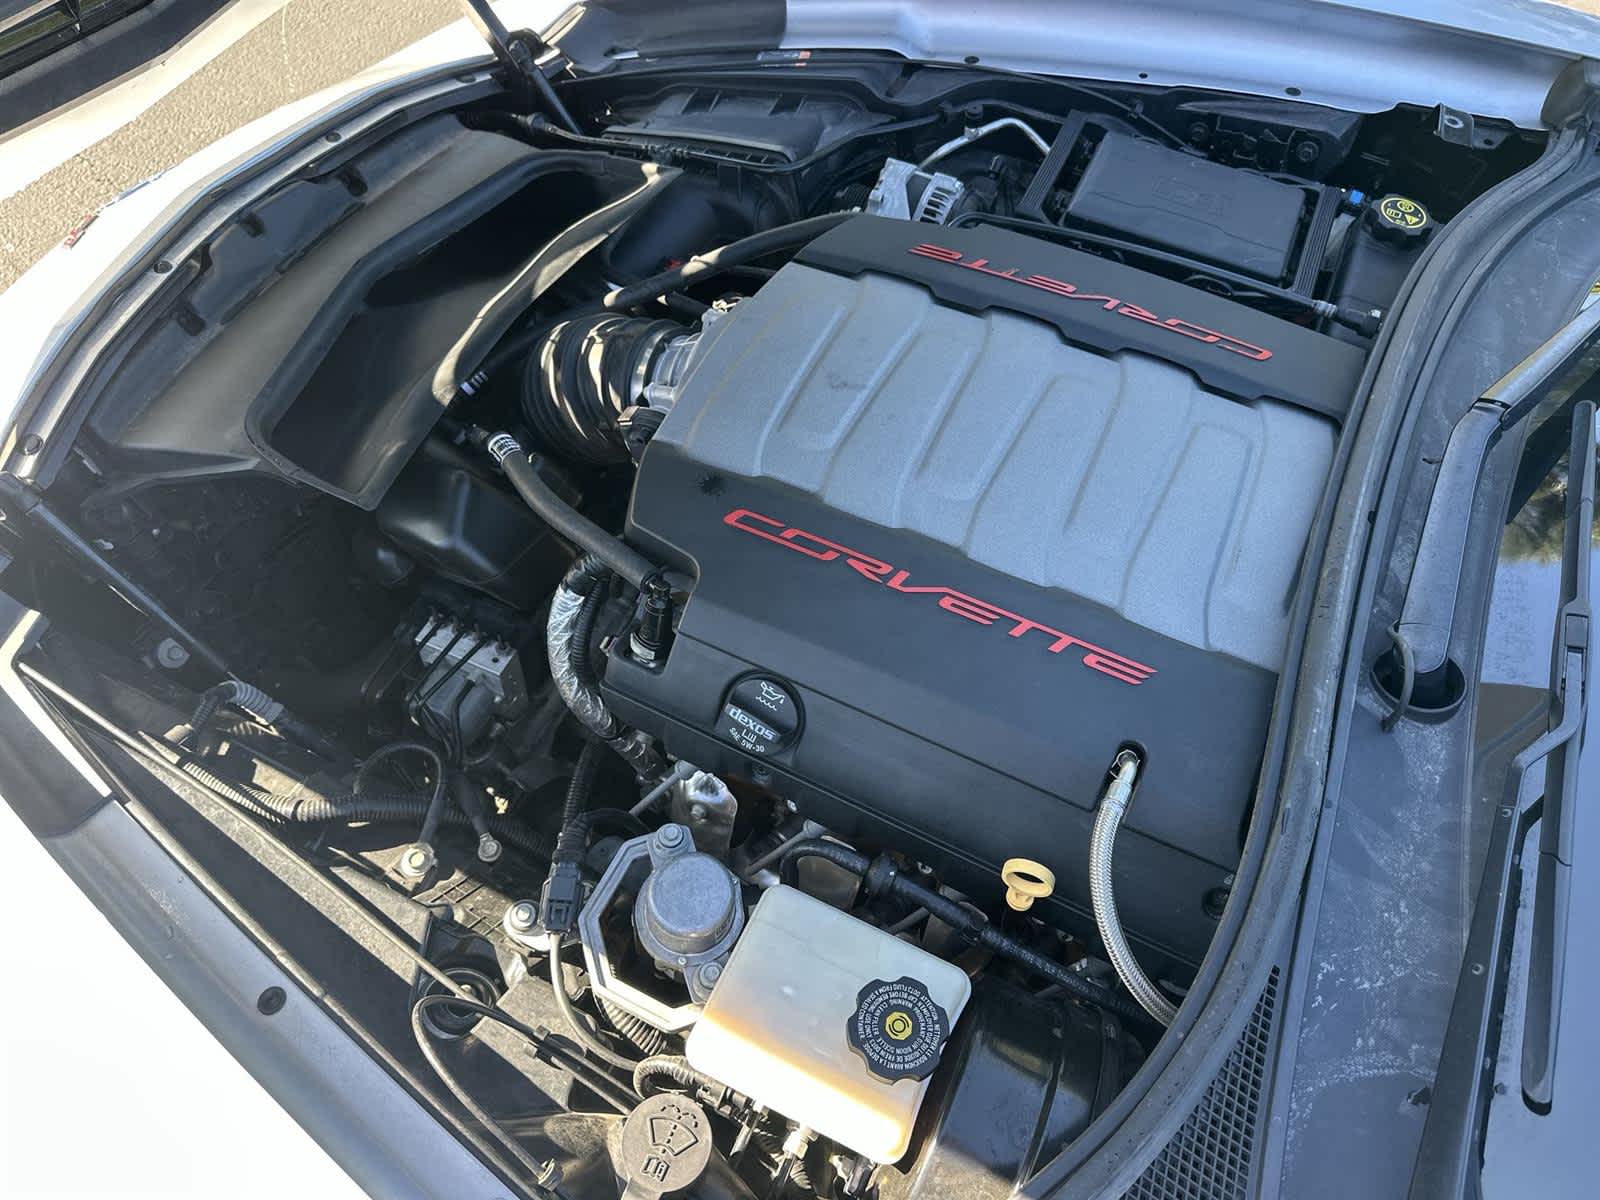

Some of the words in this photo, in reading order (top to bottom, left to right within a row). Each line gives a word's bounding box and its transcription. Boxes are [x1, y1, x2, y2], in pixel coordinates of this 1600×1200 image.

[909, 243, 1272, 361] CORVETTE
[723, 509, 1158, 685] CORVETTE
[728, 707, 777, 741] dexos
